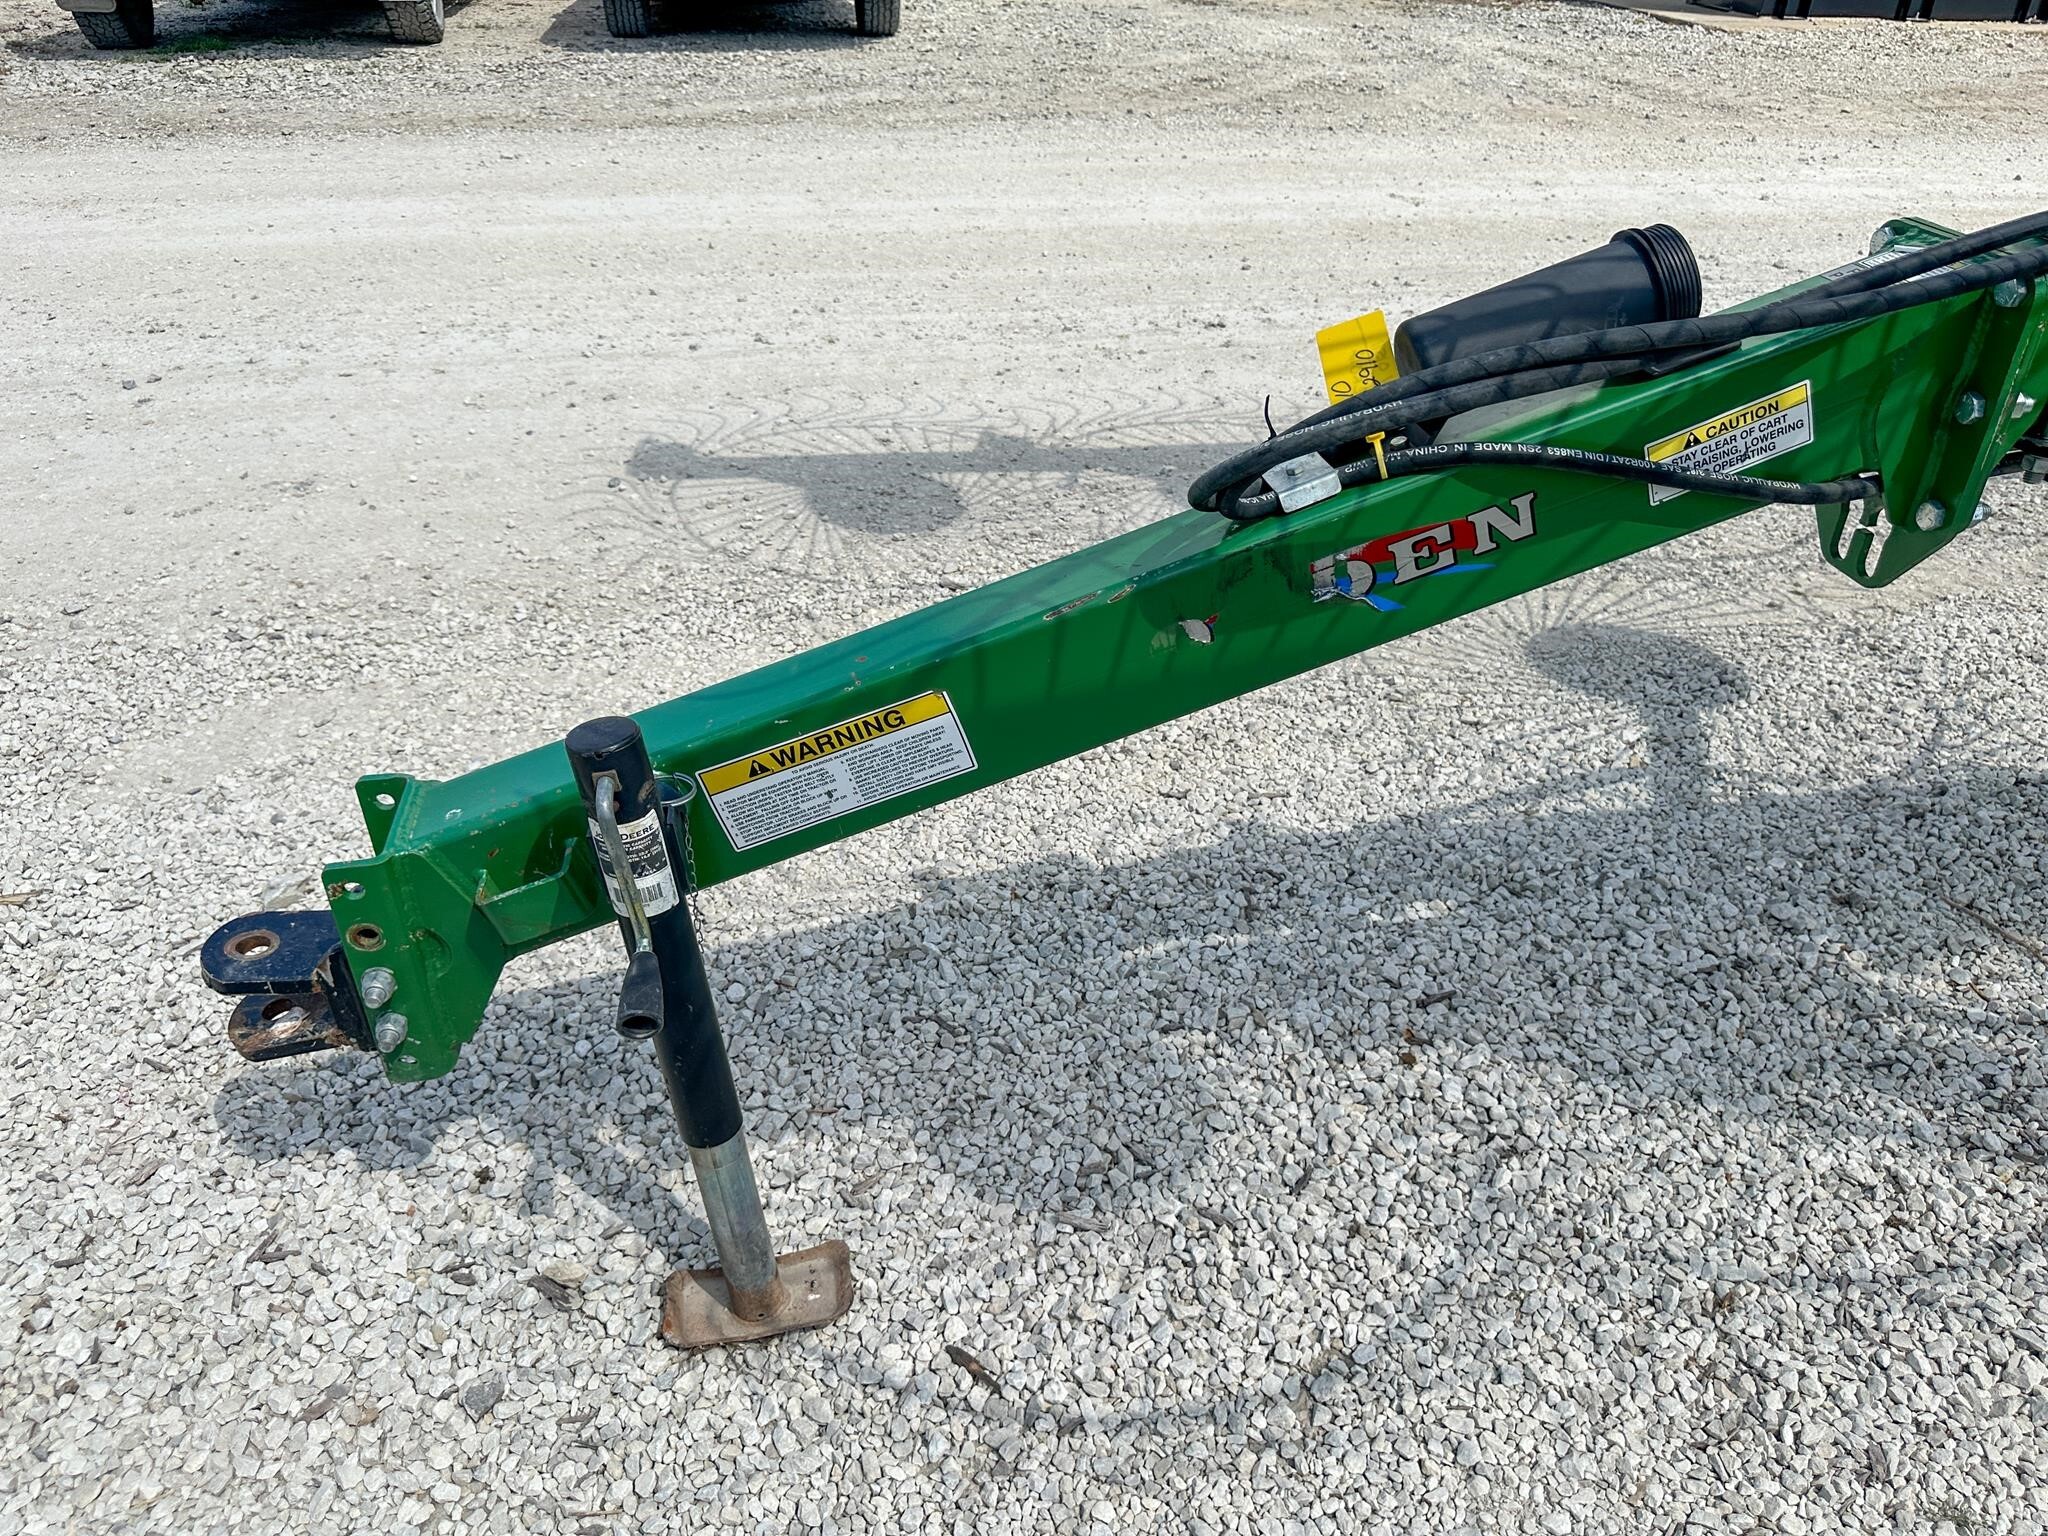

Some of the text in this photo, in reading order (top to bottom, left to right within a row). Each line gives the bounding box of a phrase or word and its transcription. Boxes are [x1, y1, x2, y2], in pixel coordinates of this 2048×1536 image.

[1706, 400, 1780, 439] CAUTION
[1474, 442, 1512, 452] MADE
[1672, 449, 1697, 466] STAY
[1700, 434, 1737, 455] CLEAR
[1740, 427, 1756, 440] OF
[1758, 414, 1788, 432] CART
[1693, 419, 1804, 472] RAISING, LOWERING
[1405, 444, 1448, 456] CHINA
[1454, 444, 1467, 452] IN
[1518, 444, 1542, 453] 2SN
[1548, 446, 1582, 458] EN853
[1585, 452, 1604, 462] DIN
[1612, 456, 1655, 469] 100R2AT
[1712, 442, 1776, 474] OPERATING
[1742, 475, 1801, 490] HYDRAULIC
[770, 710, 905, 767] WARNING
[620, 824, 654, 840] DEERE
